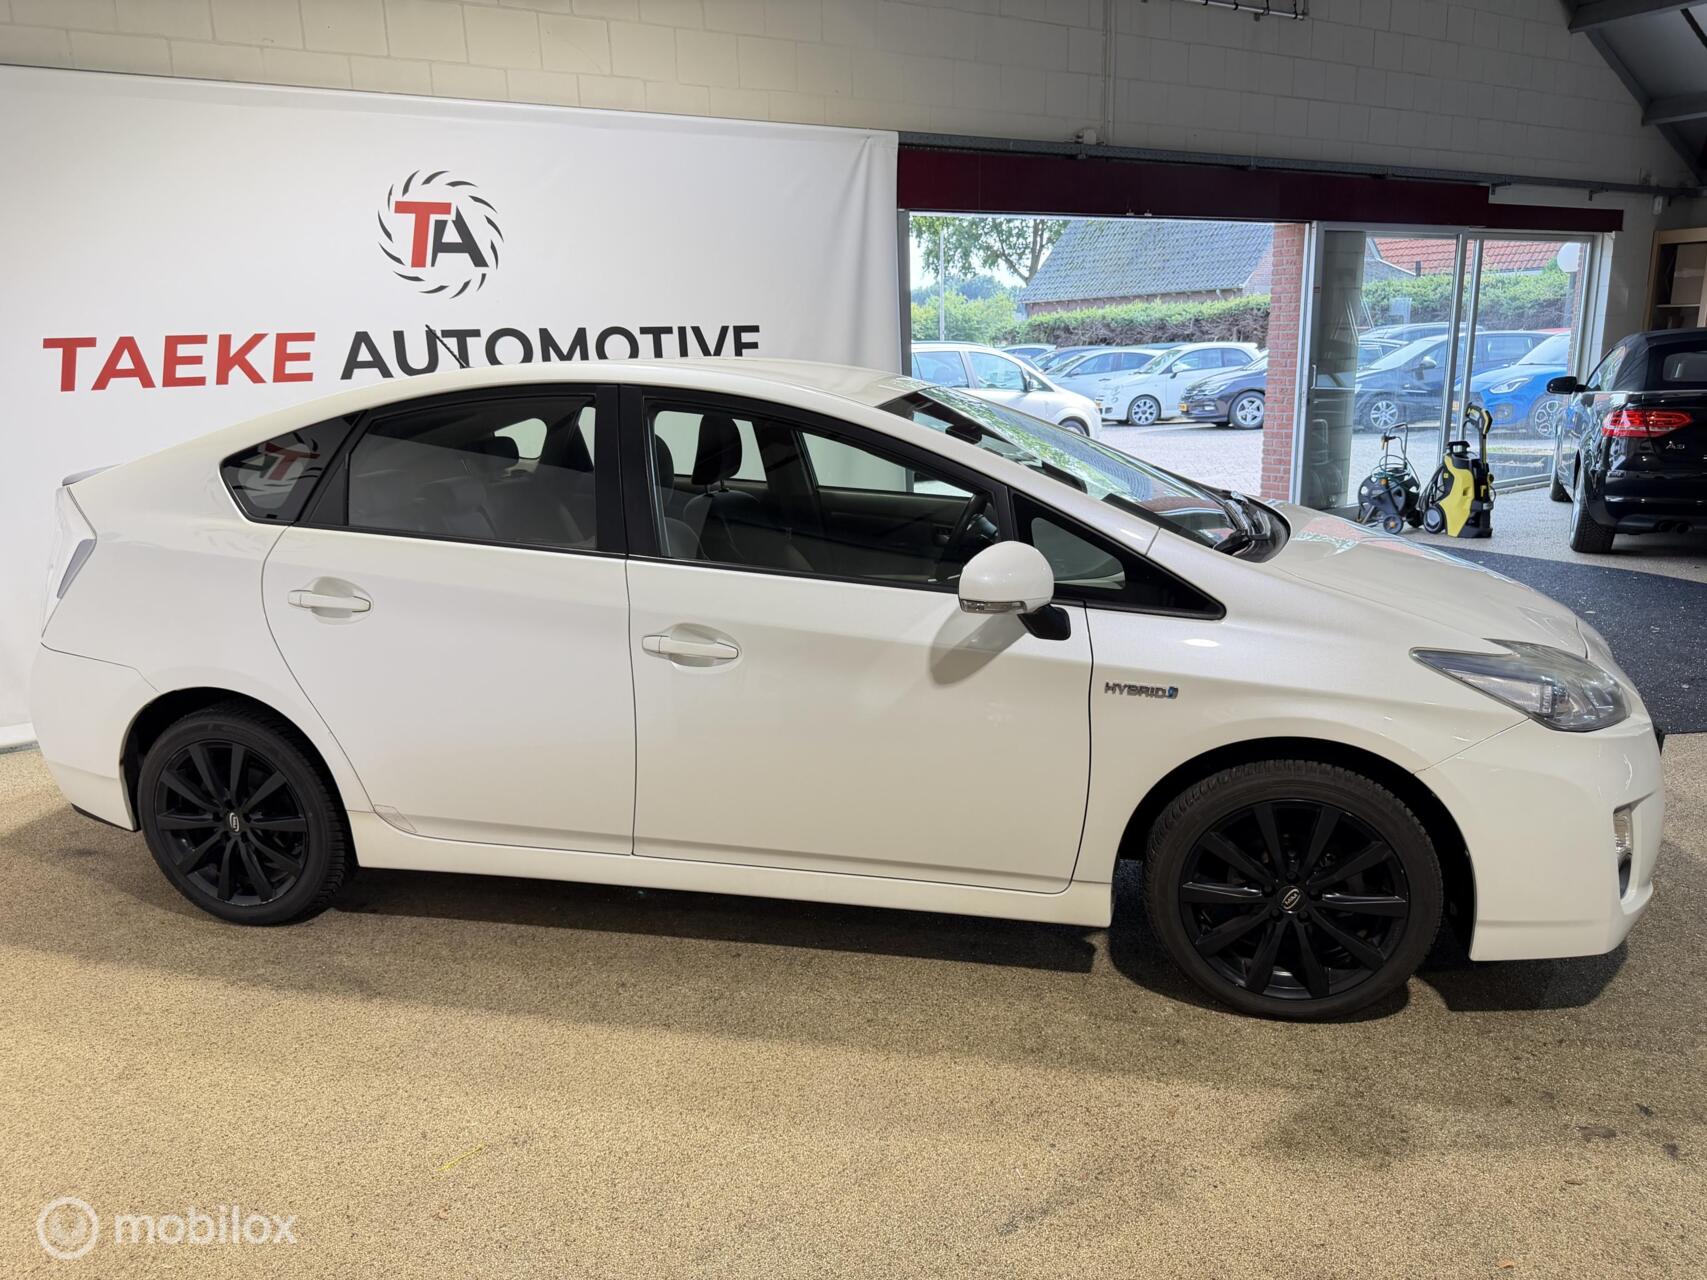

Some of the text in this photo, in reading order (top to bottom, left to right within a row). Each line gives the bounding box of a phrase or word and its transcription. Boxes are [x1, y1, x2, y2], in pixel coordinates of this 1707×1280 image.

[394, 201, 489, 268] TA
[43, 325, 760, 392] TAEKE AUTOMOTIVE
[1104, 682, 1167, 698] HYBRID
